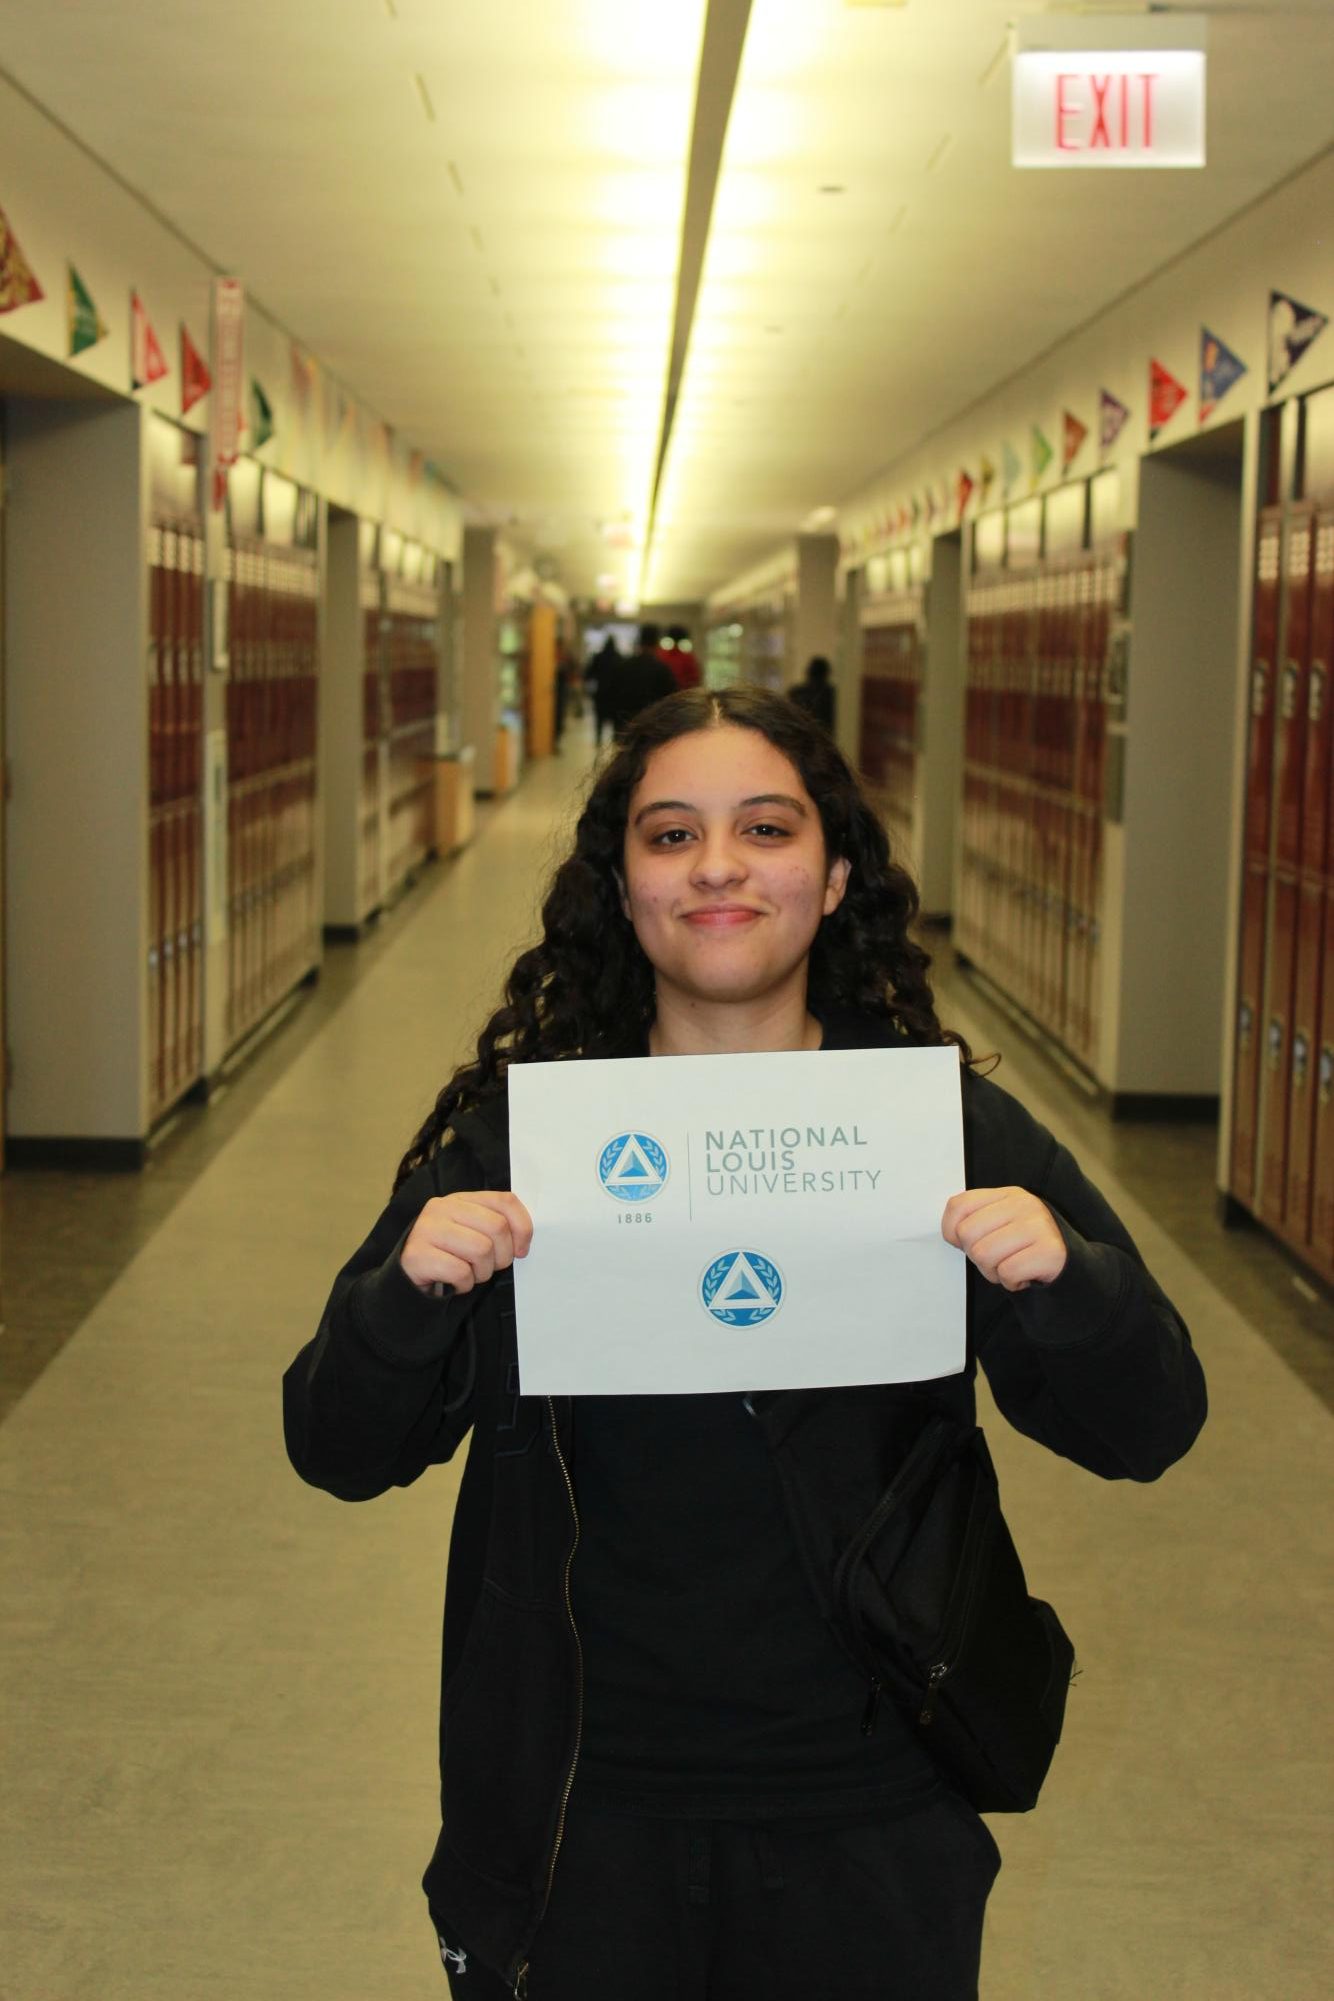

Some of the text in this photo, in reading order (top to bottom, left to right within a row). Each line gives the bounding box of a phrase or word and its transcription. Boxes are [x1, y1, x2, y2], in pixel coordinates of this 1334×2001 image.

[1056, 74, 1158, 150] EXIT
[705, 1125, 868, 1151] NATIONAL
[706, 1151, 796, 1174] LOUIS
[707, 1169, 882, 1196] UNIVERSITY
[618, 1212, 653, 1225] 1886
